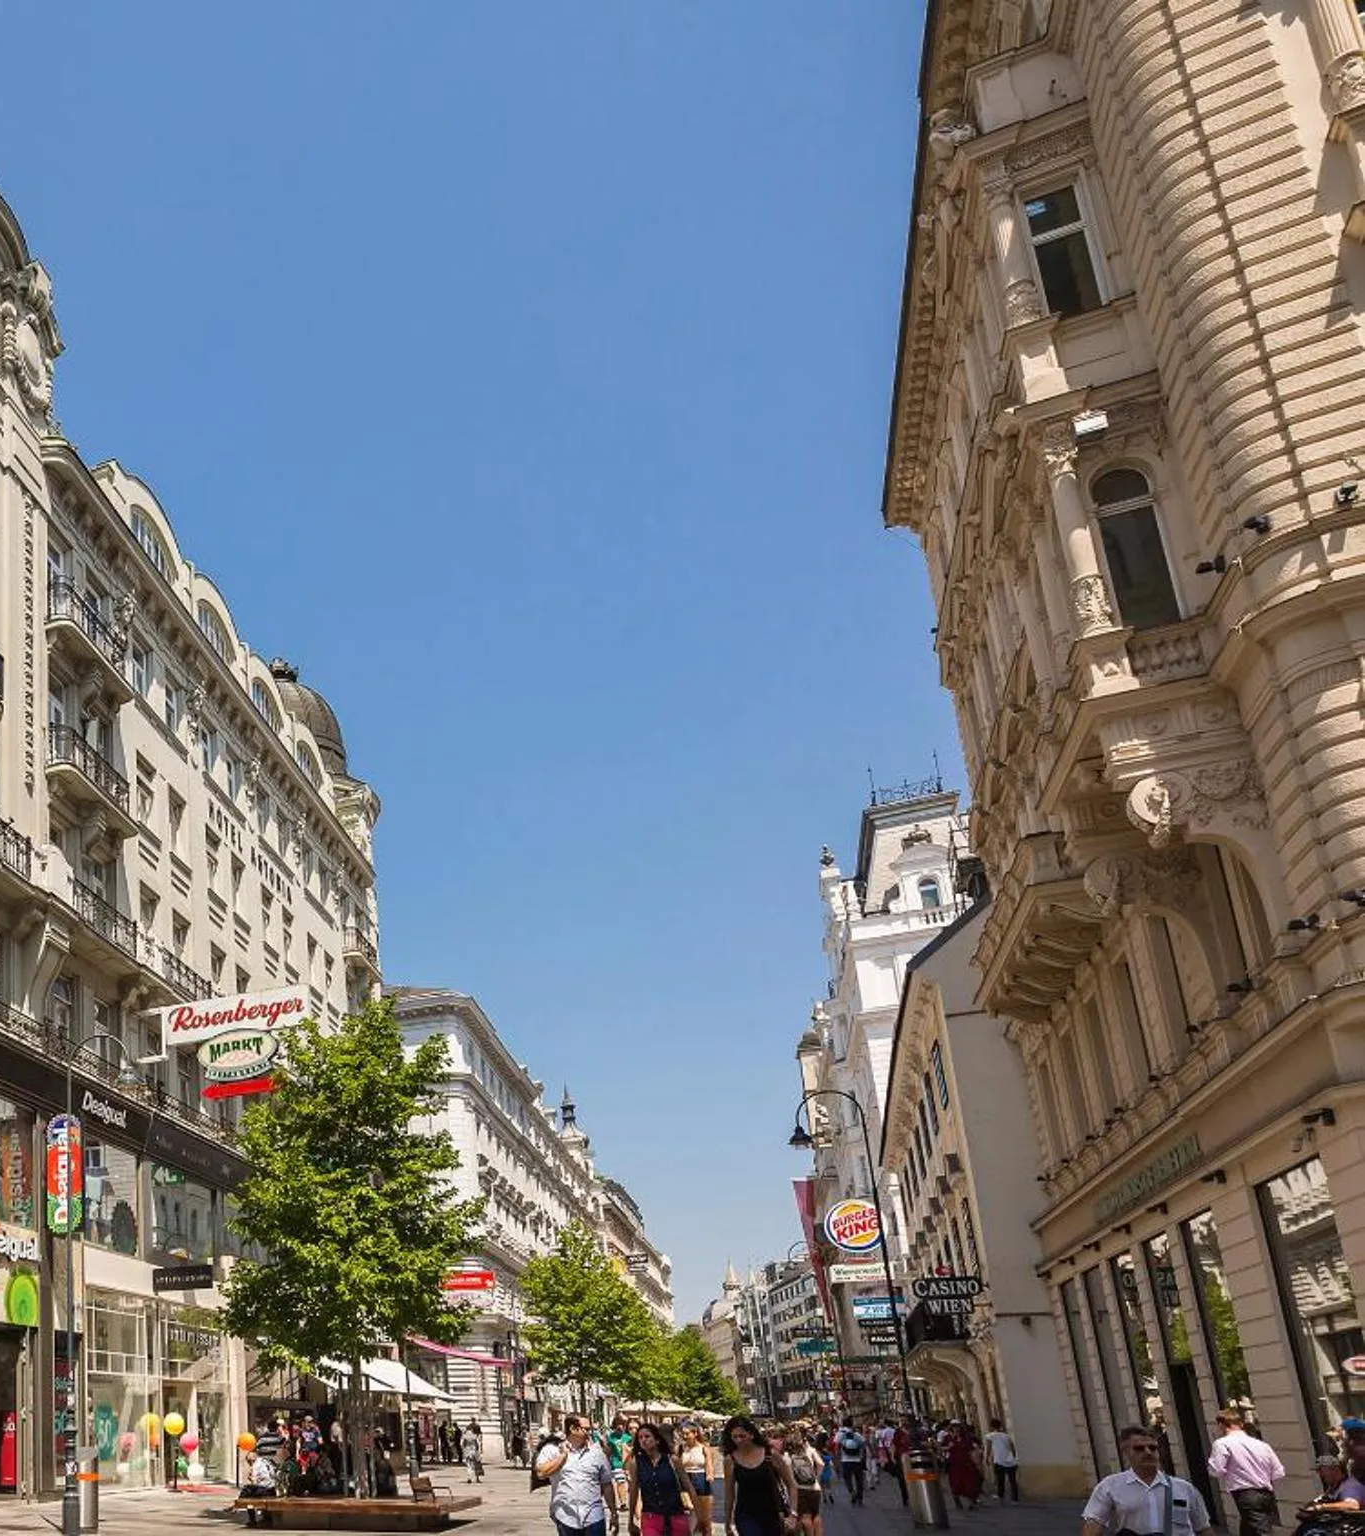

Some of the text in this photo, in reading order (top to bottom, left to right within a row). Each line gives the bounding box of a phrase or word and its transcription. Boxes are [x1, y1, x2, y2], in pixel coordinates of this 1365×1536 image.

[208, 798, 292, 905] HOTEL ASTORIA
[168, 997, 305, 1032] Rosenberger
[209, 1036, 263, 1063] MARKT
[81, 1089, 126, 1128] Desigual
[833, 1207, 878, 1230] BURGER
[836, 1217, 880, 1243] KING
[915, 1281, 980, 1297] CASINO
[928, 1299, 973, 1315] WIEN
